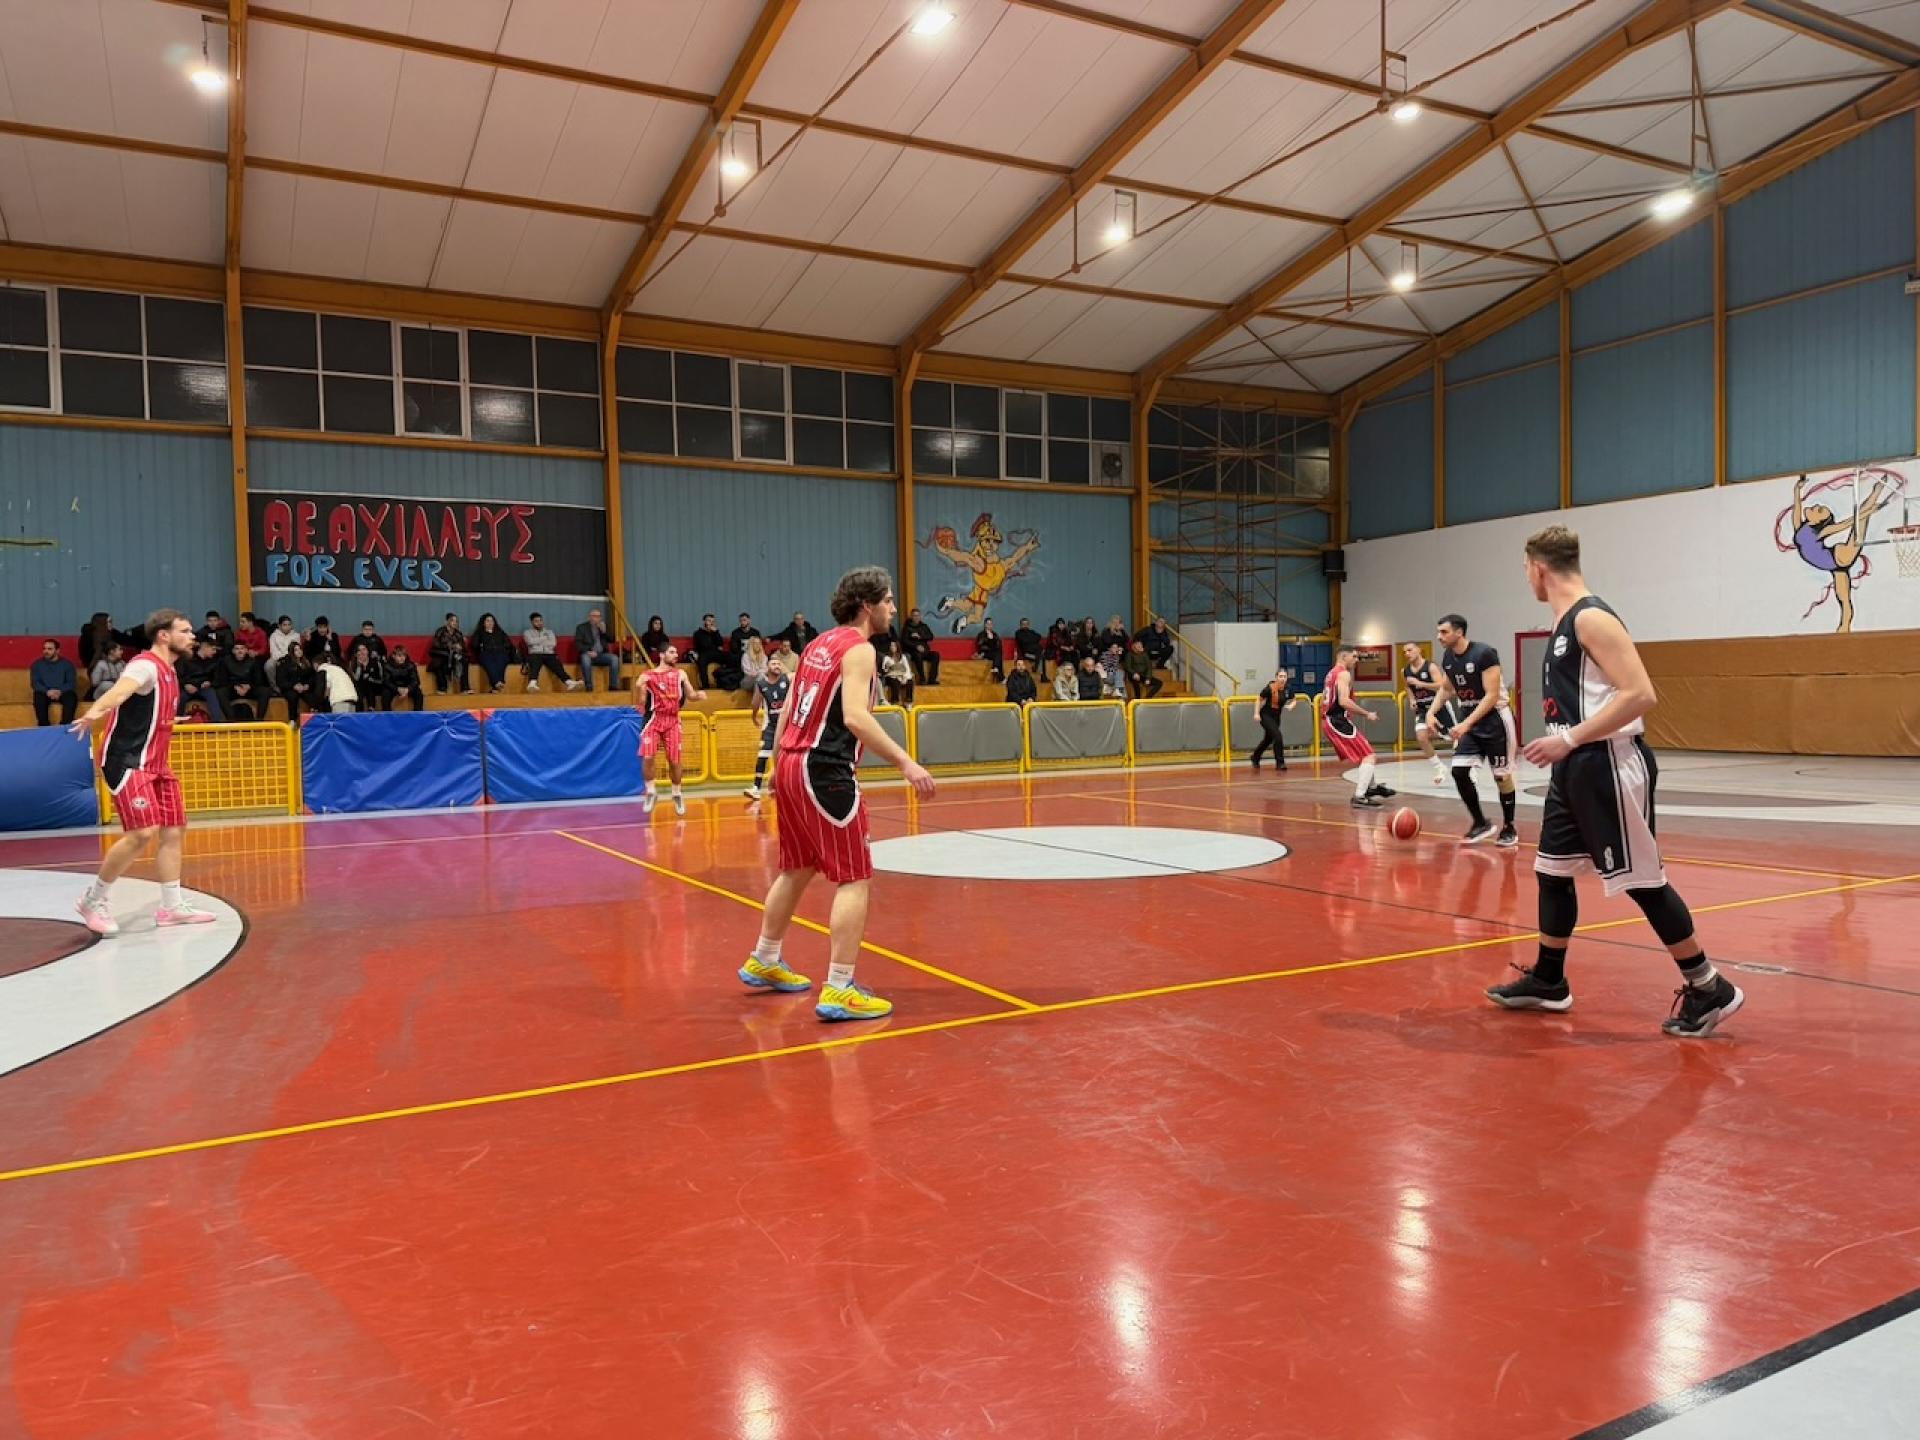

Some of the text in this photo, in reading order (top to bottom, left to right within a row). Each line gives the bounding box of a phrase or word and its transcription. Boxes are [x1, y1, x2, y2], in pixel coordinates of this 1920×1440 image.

[265, 553, 452, 592] FOR EVER
[792, 680, 819, 728] 14
[1604, 846, 1615, 871] 8
